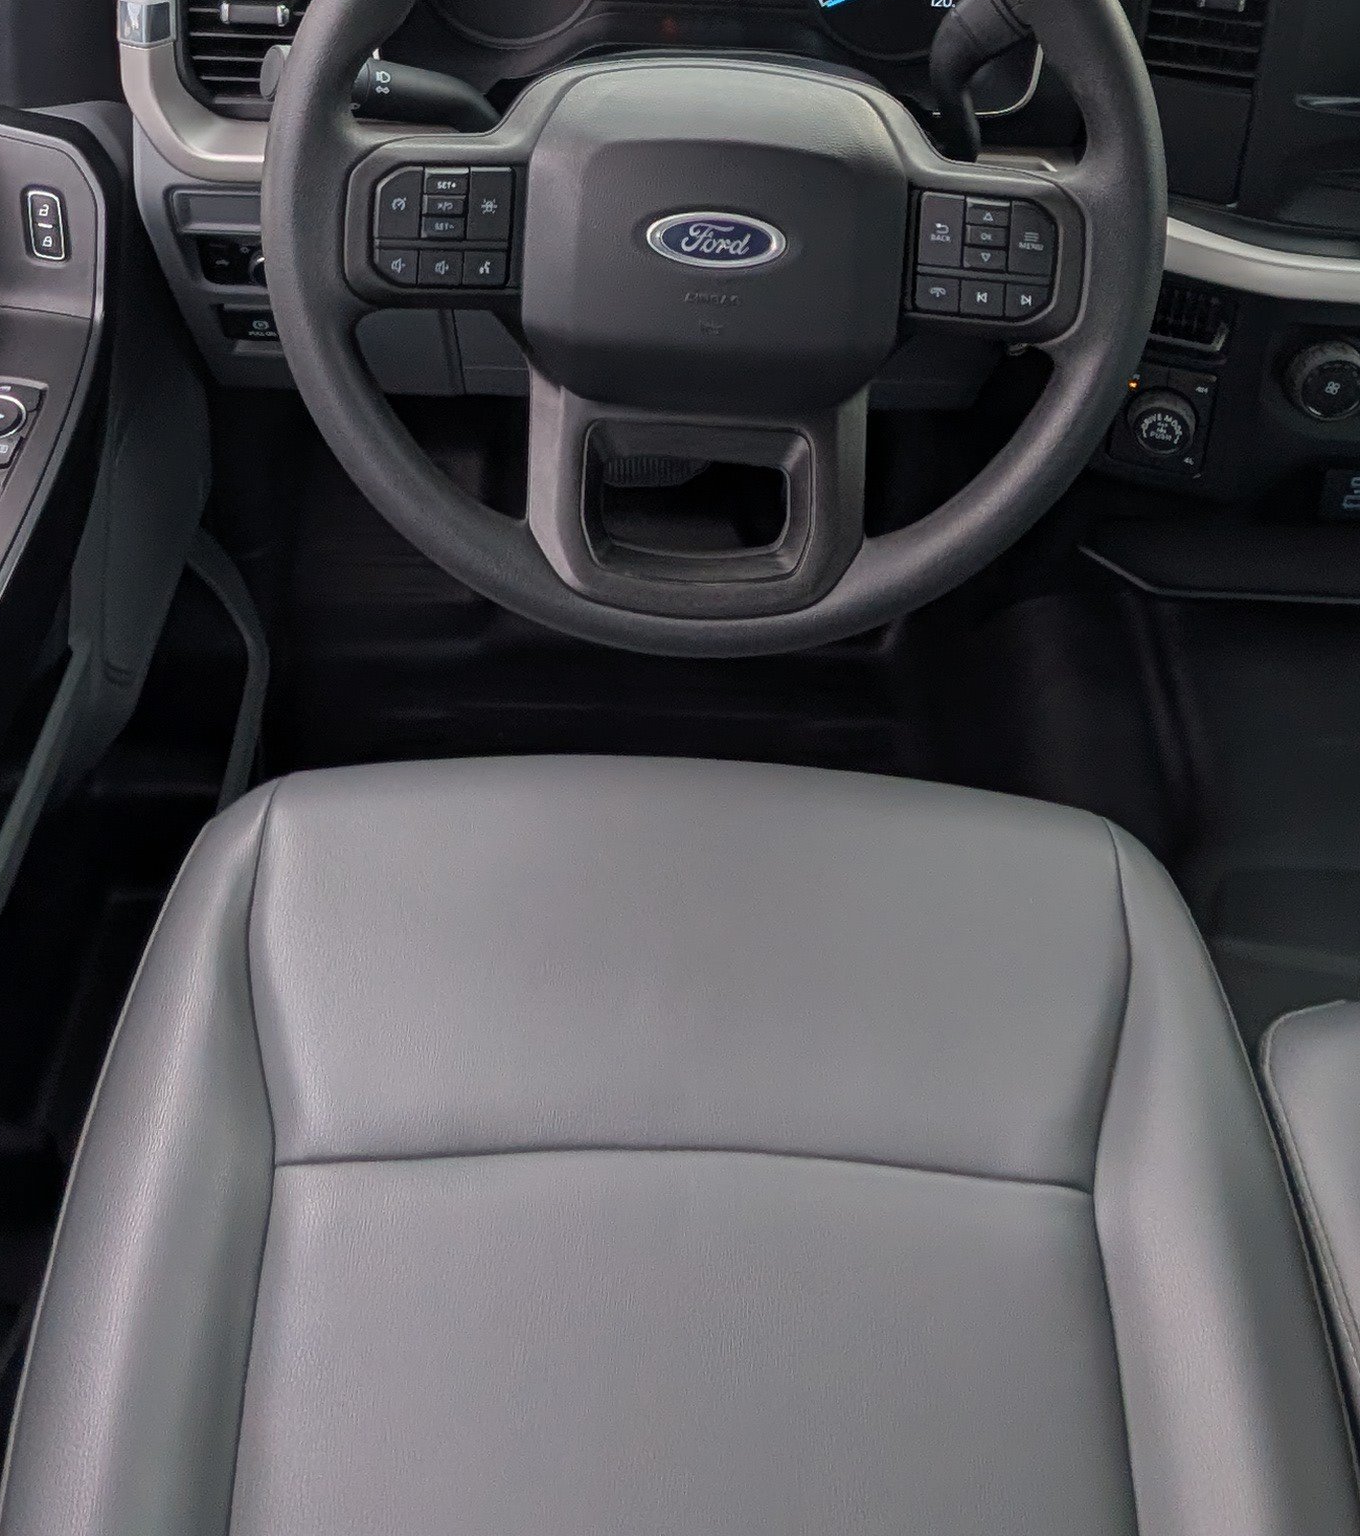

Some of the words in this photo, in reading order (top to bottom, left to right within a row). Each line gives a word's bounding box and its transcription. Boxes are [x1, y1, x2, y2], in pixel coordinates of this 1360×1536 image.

[681, 222, 751, 255] Ford
[930, 233, 951, 243] BACK
[981, 232, 992, 241] OK
[1019, 241, 1044, 252] MENU
